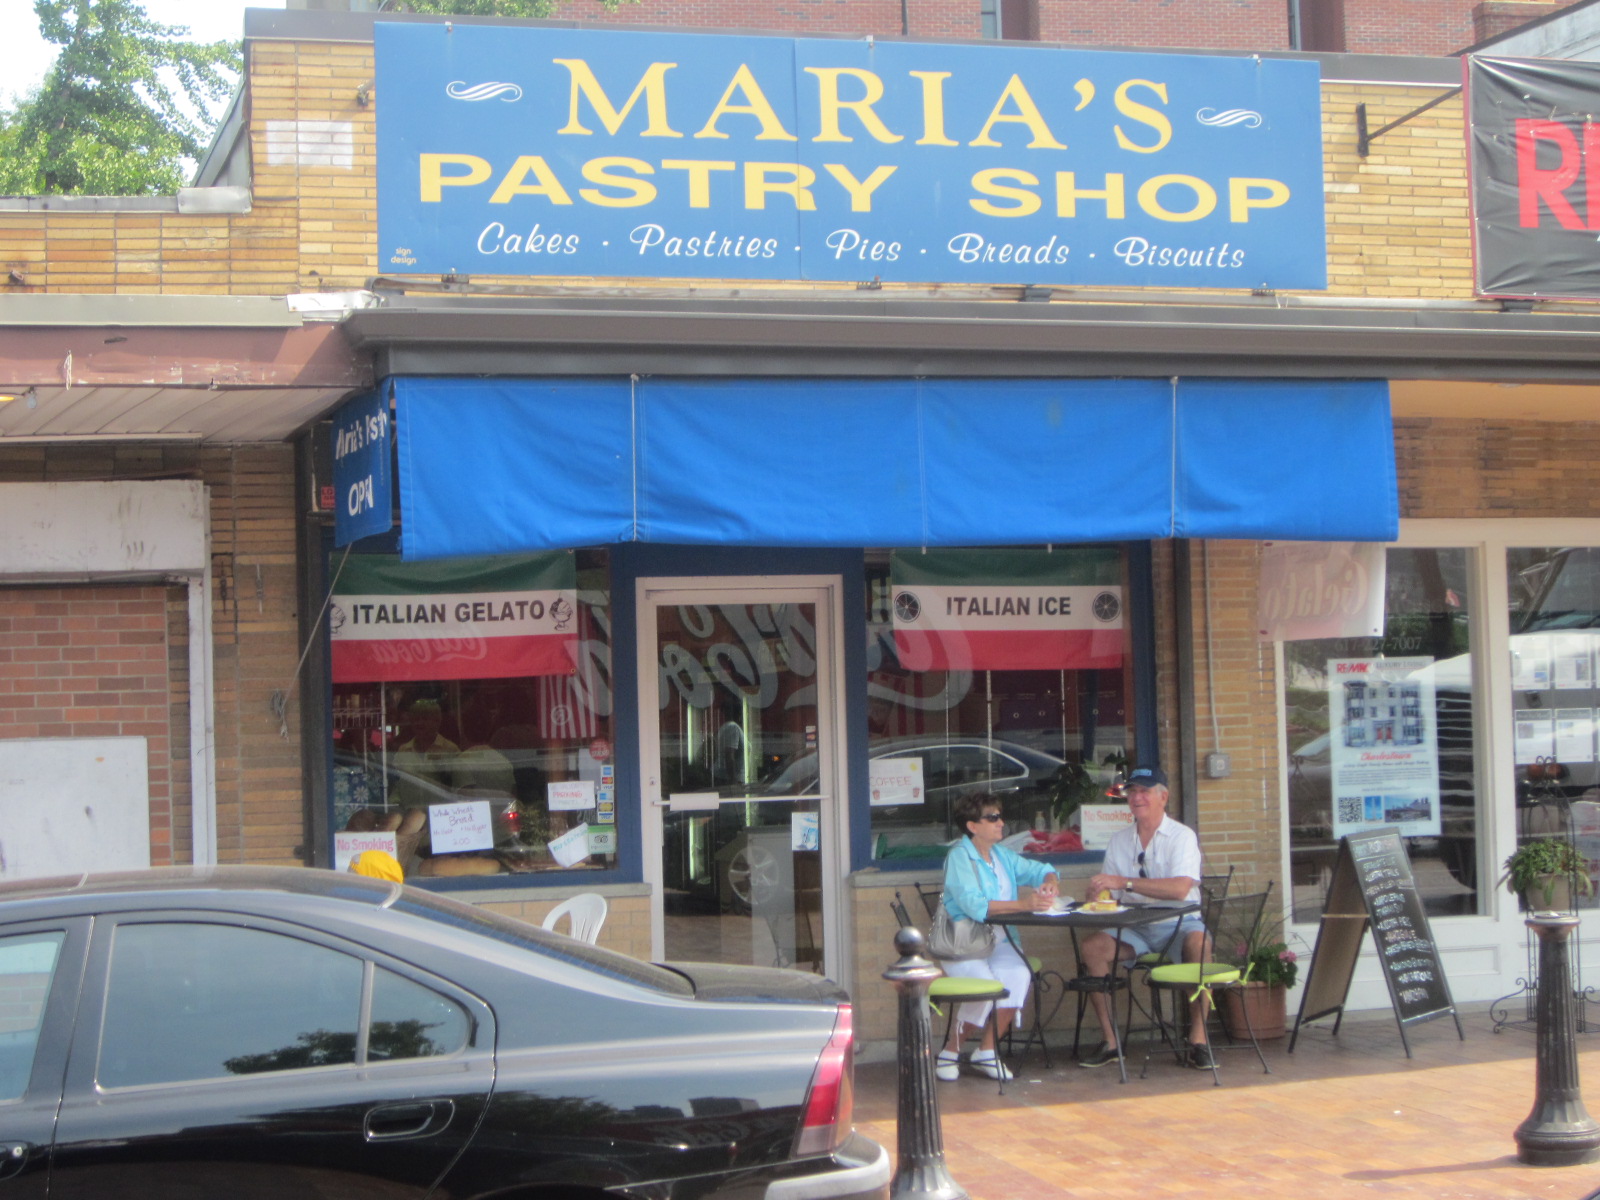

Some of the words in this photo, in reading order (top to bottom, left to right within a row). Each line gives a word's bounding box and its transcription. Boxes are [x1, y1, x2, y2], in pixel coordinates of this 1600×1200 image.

[553, 58, 1172, 154] MARIA'S
[1515, 117, 1600, 230] R
[420, 153, 898, 213] PASTRY
[969, 167, 1290, 223] SHOP
[477, 221, 580, 256] Cakes
[629, 223, 778, 259] Pastries
[826, 229, 902, 262] Pies
[947, 232, 1070, 265] Breads
[1113, 236, 1246, 269] Biscuits
[353, 603, 447, 625] ITALIAN
[455, 600, 545, 623] GELATO
[947, 597, 1031, 616] ITALIAN
[1038, 597, 1072, 616] ICE
[870, 776, 912, 787] COFFEE
[1096, 809, 1134, 823] Smoking
[337, 839, 350, 850] No
[351, 838, 394, 852] Smoking
